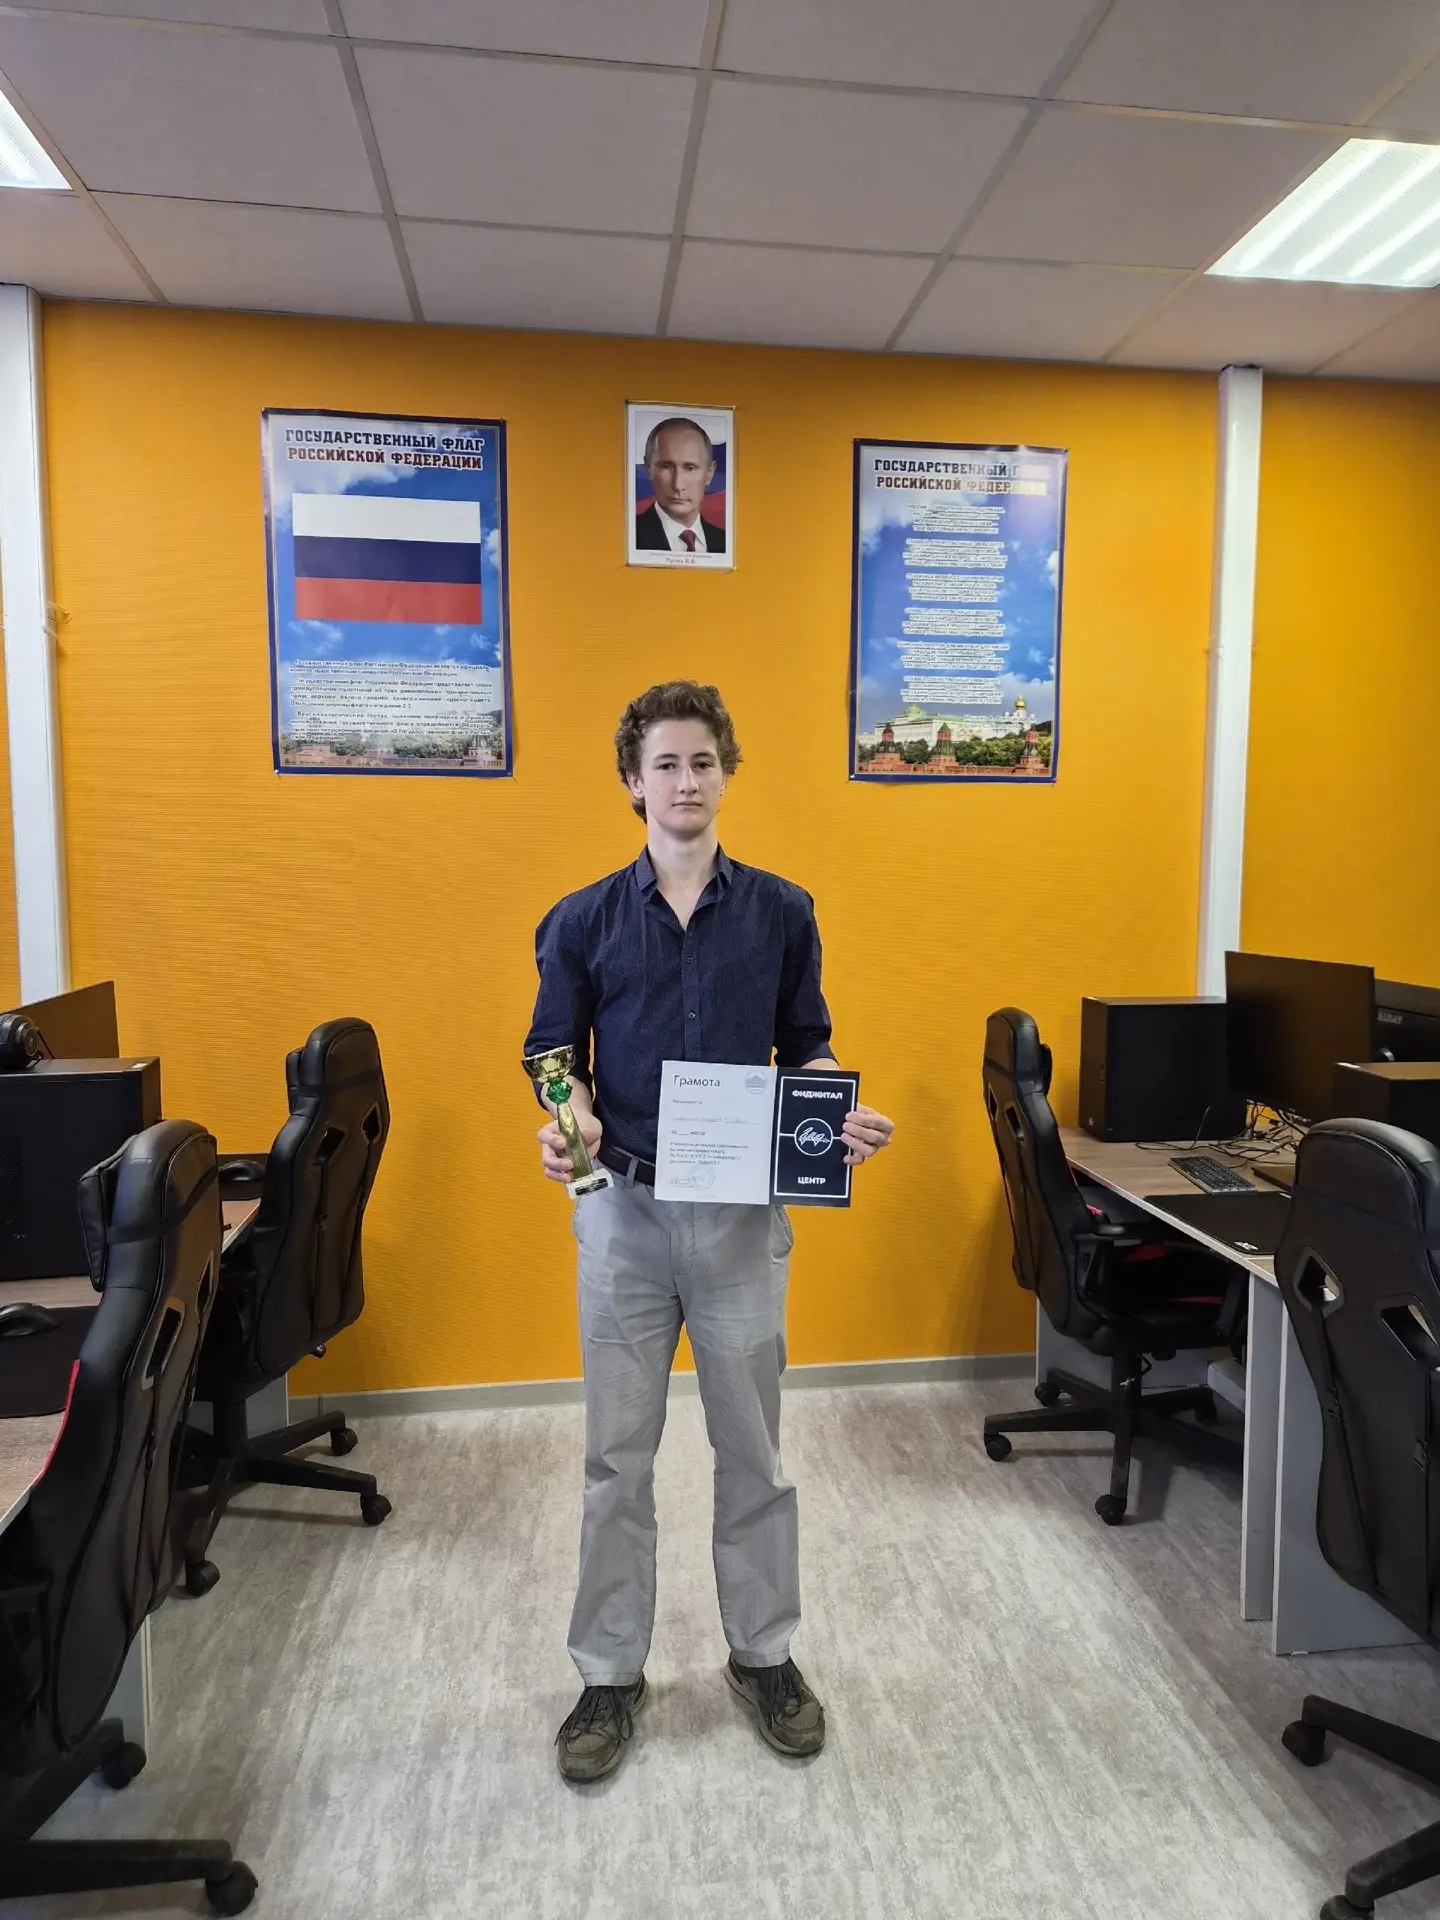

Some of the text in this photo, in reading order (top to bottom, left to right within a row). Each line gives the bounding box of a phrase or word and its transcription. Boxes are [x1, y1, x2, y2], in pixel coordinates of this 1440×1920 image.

[285, 428, 485, 452] ГОСУДАРСТВЕННЫЙ ФЛАГ
[287, 446, 483, 470] РОССИЙСКОЙ ФЕДЕРАЦИИ
[874, 458, 1008, 477] ГОСУДАРСТВЕННЫЙ
[876, 475, 1047, 495] РОССИЙСКОЙ ФЕДЕР
[673, 1074, 721, 1087] Грамота
[792, 1089, 843, 1100] ФИДЖИТАЛ
[797, 1176, 827, 1185] ЦЕНТР
